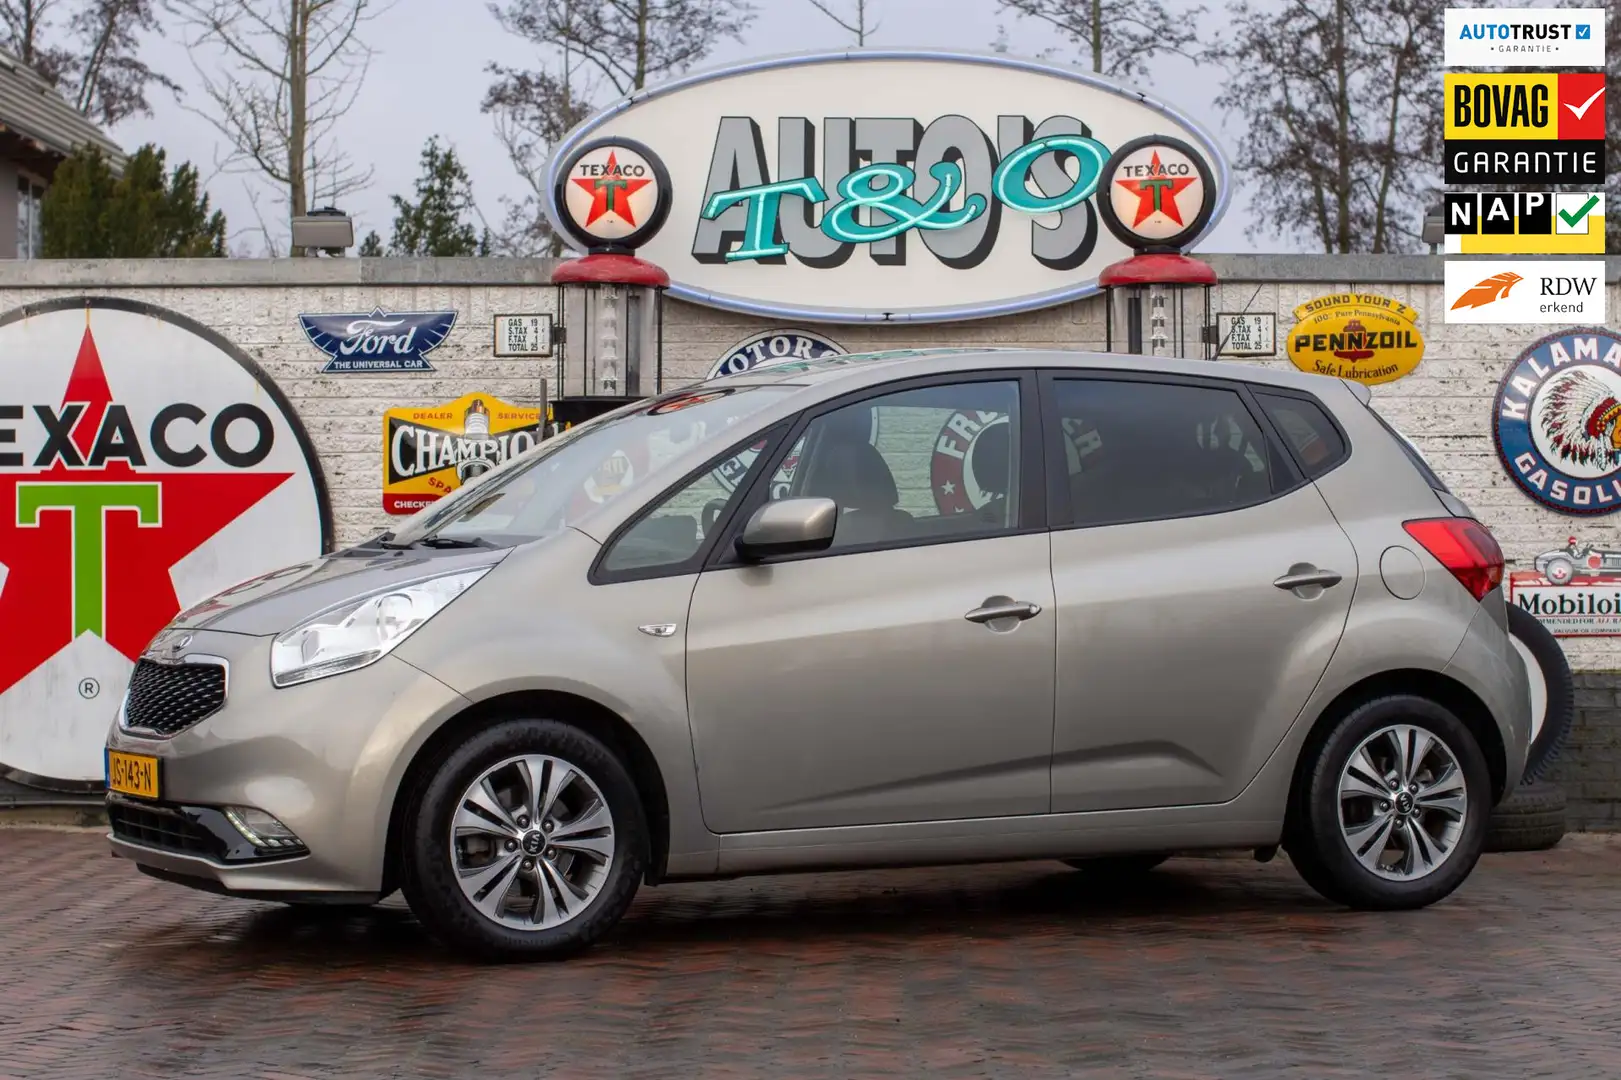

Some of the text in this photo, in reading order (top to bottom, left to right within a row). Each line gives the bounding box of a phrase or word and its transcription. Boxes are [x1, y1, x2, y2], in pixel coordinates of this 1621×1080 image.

[580, 164, 645, 177] TEXACO
[1123, 163, 1189, 177] TEXACO
[1305, 294, 1408, 314] SOUND YOUR Z
[508, 319, 538, 327] GAS 19
[1231, 317, 1246, 325] GAS
[339, 319, 418, 355] Ford
[508, 327, 528, 335] S.TAX
[508, 344, 528, 352] TOTAL
[1231, 342, 1252, 350] TOTAL
[1295, 331, 1417, 353] PENNZOIL
[715, 336, 814, 377] OTOR
[334, 360, 423, 369] THE UNIVERSAL CAR
[1312, 359, 1399, 379] Safe Lubrication
[413, 412, 453, 420] DEALER
[391, 421, 559, 478] CHAMPIO
[112, 757, 152, 792] JS-143-N
